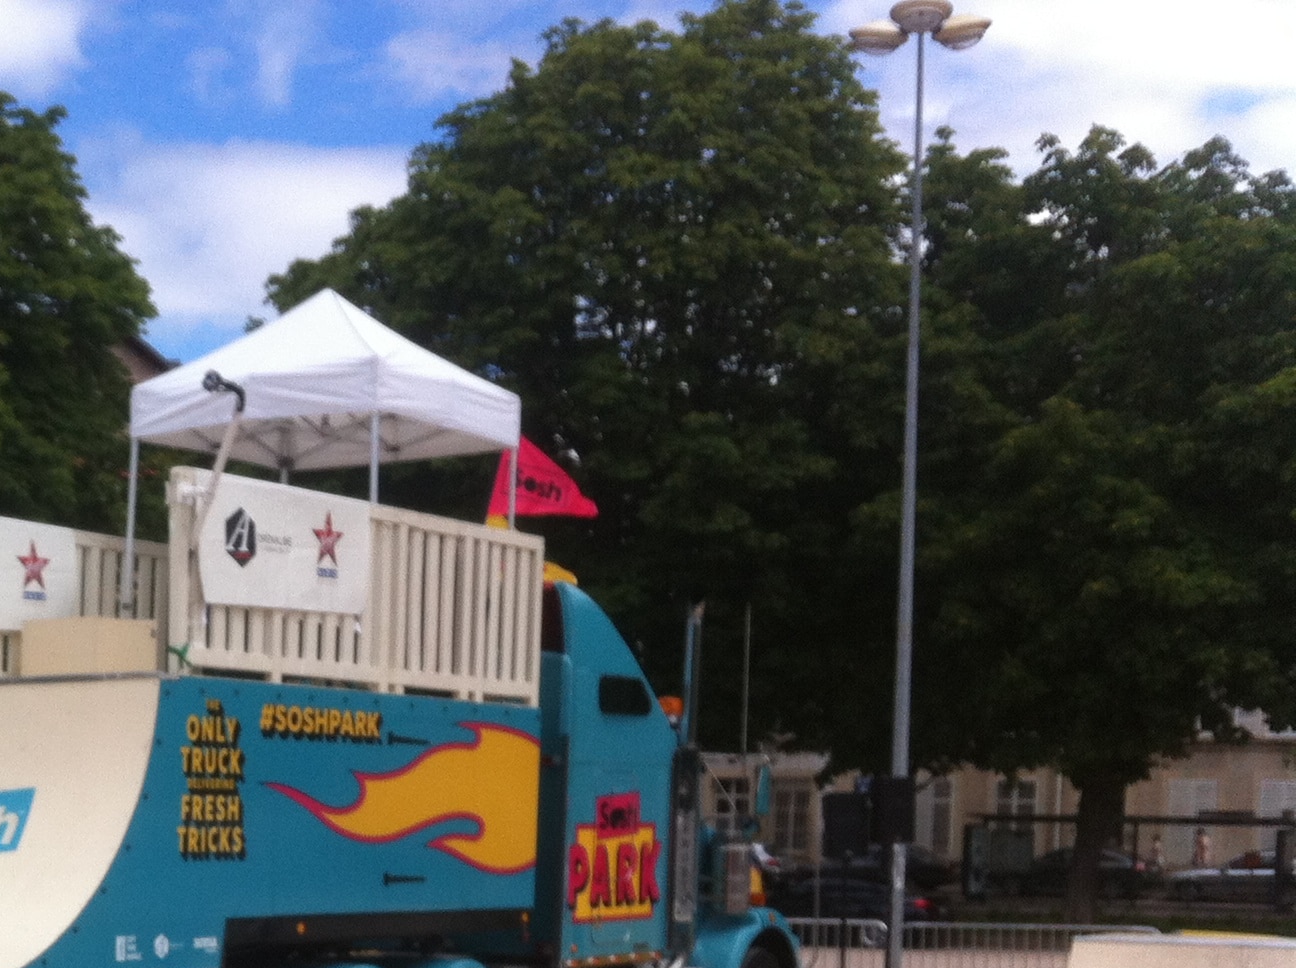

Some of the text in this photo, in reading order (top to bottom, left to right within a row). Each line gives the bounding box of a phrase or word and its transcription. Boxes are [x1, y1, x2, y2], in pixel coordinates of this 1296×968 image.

[186, 714, 241, 743] ONLY
[260, 703, 383, 741] #SOSHPARK
[180, 746, 244, 776] TRUCK
[181, 795, 242, 822] FRESH
[177, 825, 244, 855] TRICKS
[567, 840, 662, 909] PARK
